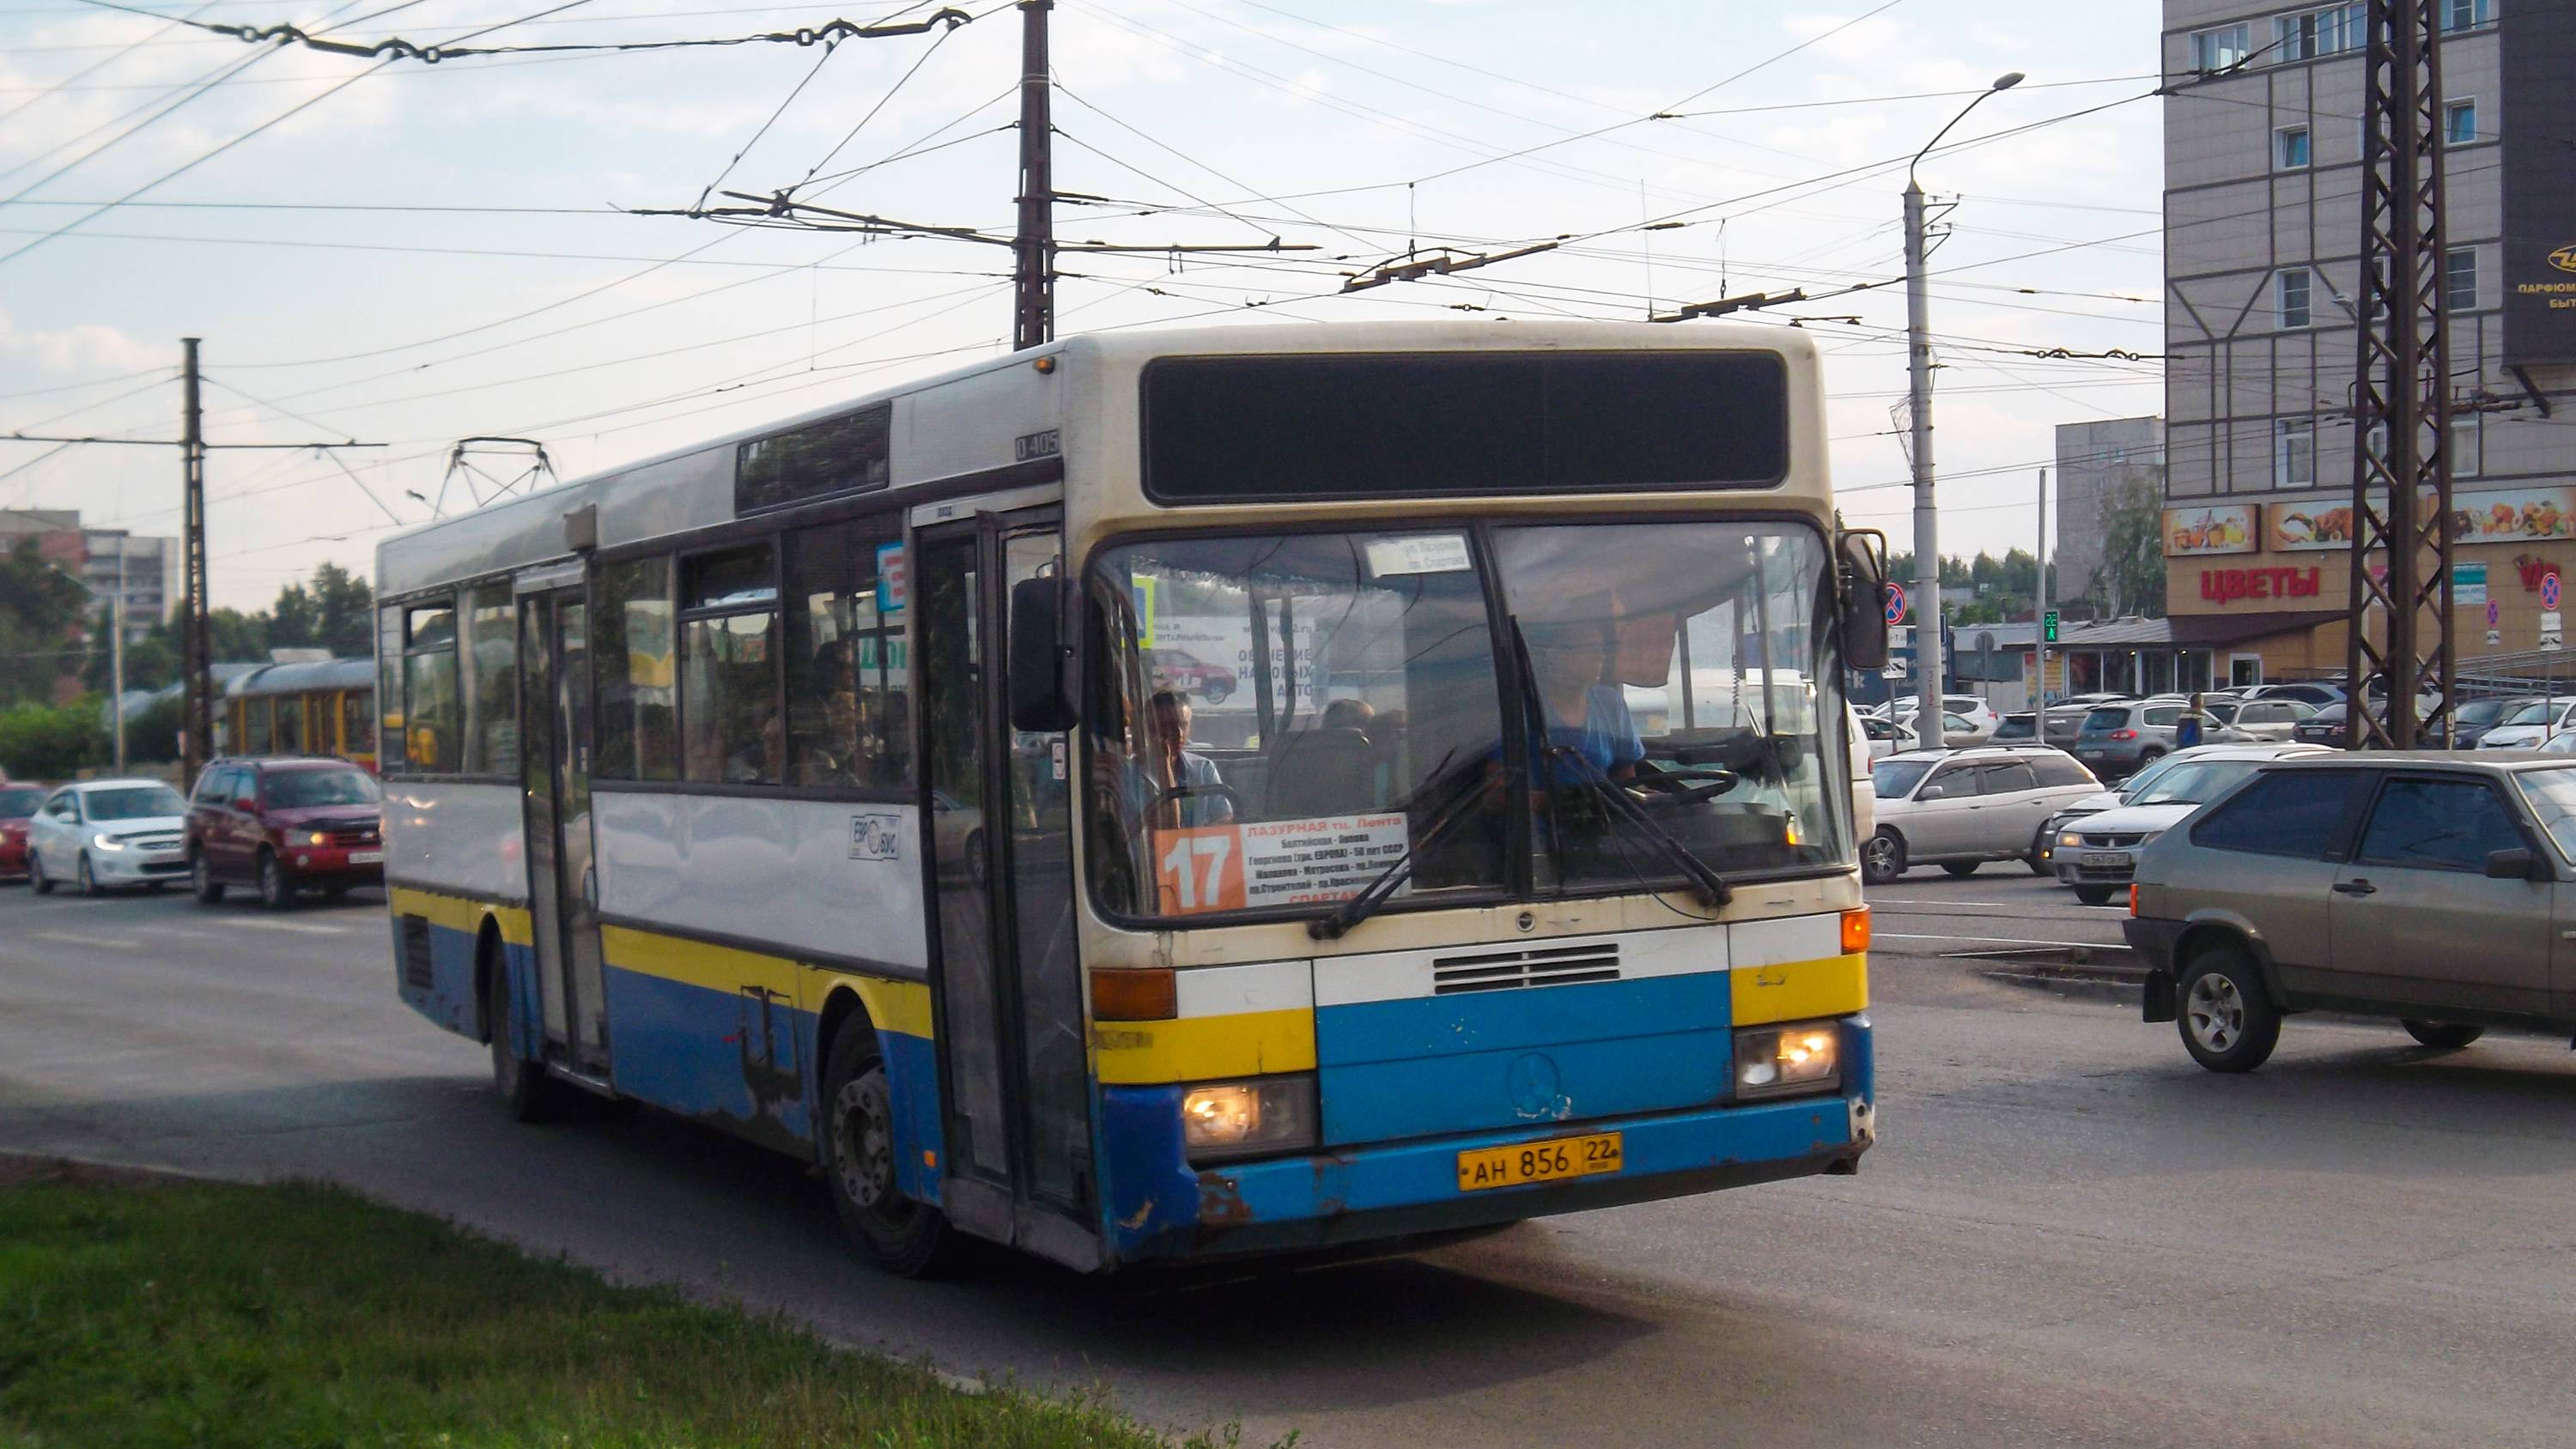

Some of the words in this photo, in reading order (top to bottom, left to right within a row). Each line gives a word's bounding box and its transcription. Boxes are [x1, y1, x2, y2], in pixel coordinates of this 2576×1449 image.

[1030, 435, 1060, 455] 405
[2200, 566, 2318, 604] ЦВЕТЫ
[1277, 683, 1312, 697] АТО
[1248, 821, 1327, 839] ЛАЗУРНАЯ
[1382, 843, 1404, 854] СССР
[1164, 834, 1232, 910] 17
[1474, 1159, 1506, 1184] АН
[1520, 1145, 1569, 1178] 856
[1586, 1139, 1611, 1161] 22
